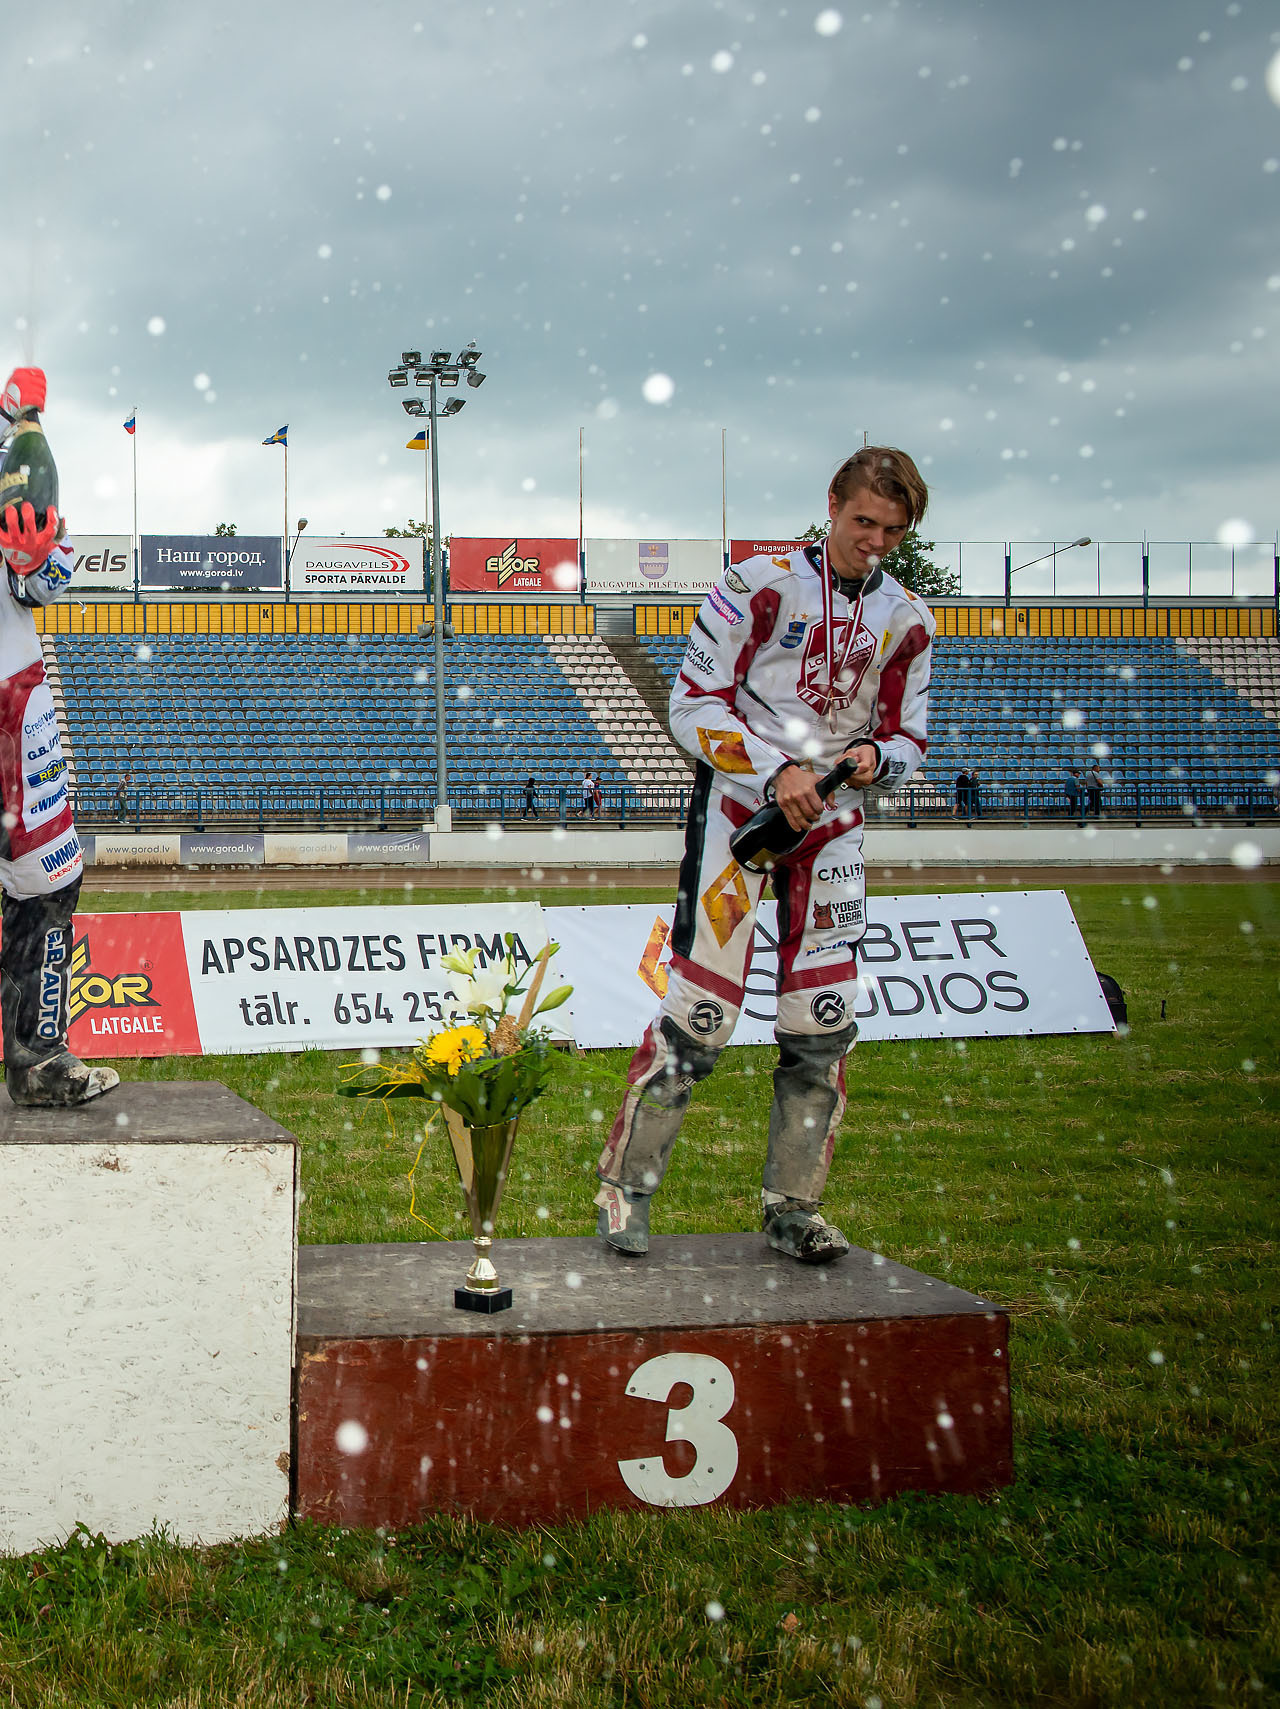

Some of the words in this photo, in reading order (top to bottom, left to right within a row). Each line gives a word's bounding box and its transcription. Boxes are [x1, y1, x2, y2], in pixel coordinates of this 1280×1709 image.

[753, 544, 795, 553] Daugavpils
[157, 548, 201, 563] Наш
[305, 561, 389, 569] DAUGAVPILS
[179, 569, 244, 578] www.gorod.lv
[305, 574, 347, 584] SPORTA
[350, 572, 406, 584] PĀRVALDE
[513, 577, 542, 587] LATGALE
[590, 580, 645, 589] DAUGAVPILS
[262, 609, 270, 619] K
[672, 611, 680, 621] H
[105, 845, 170, 855] www.gorod.lv
[190, 844, 255, 854] www.gorod.lv
[357, 843, 420, 853] www.gorod.lv
[48, 864, 73, 883] ENERGY
[838, 910, 862, 924] BEAR
[201, 934, 406, 975] APSARDZES
[743, 970, 1031, 1021] SUDIOS
[239, 991, 311, 1026] tālr.
[333, 992, 394, 1025] 654
[90, 1015, 164, 1035] LATGALE
[617, 1352, 739, 1508] 3
